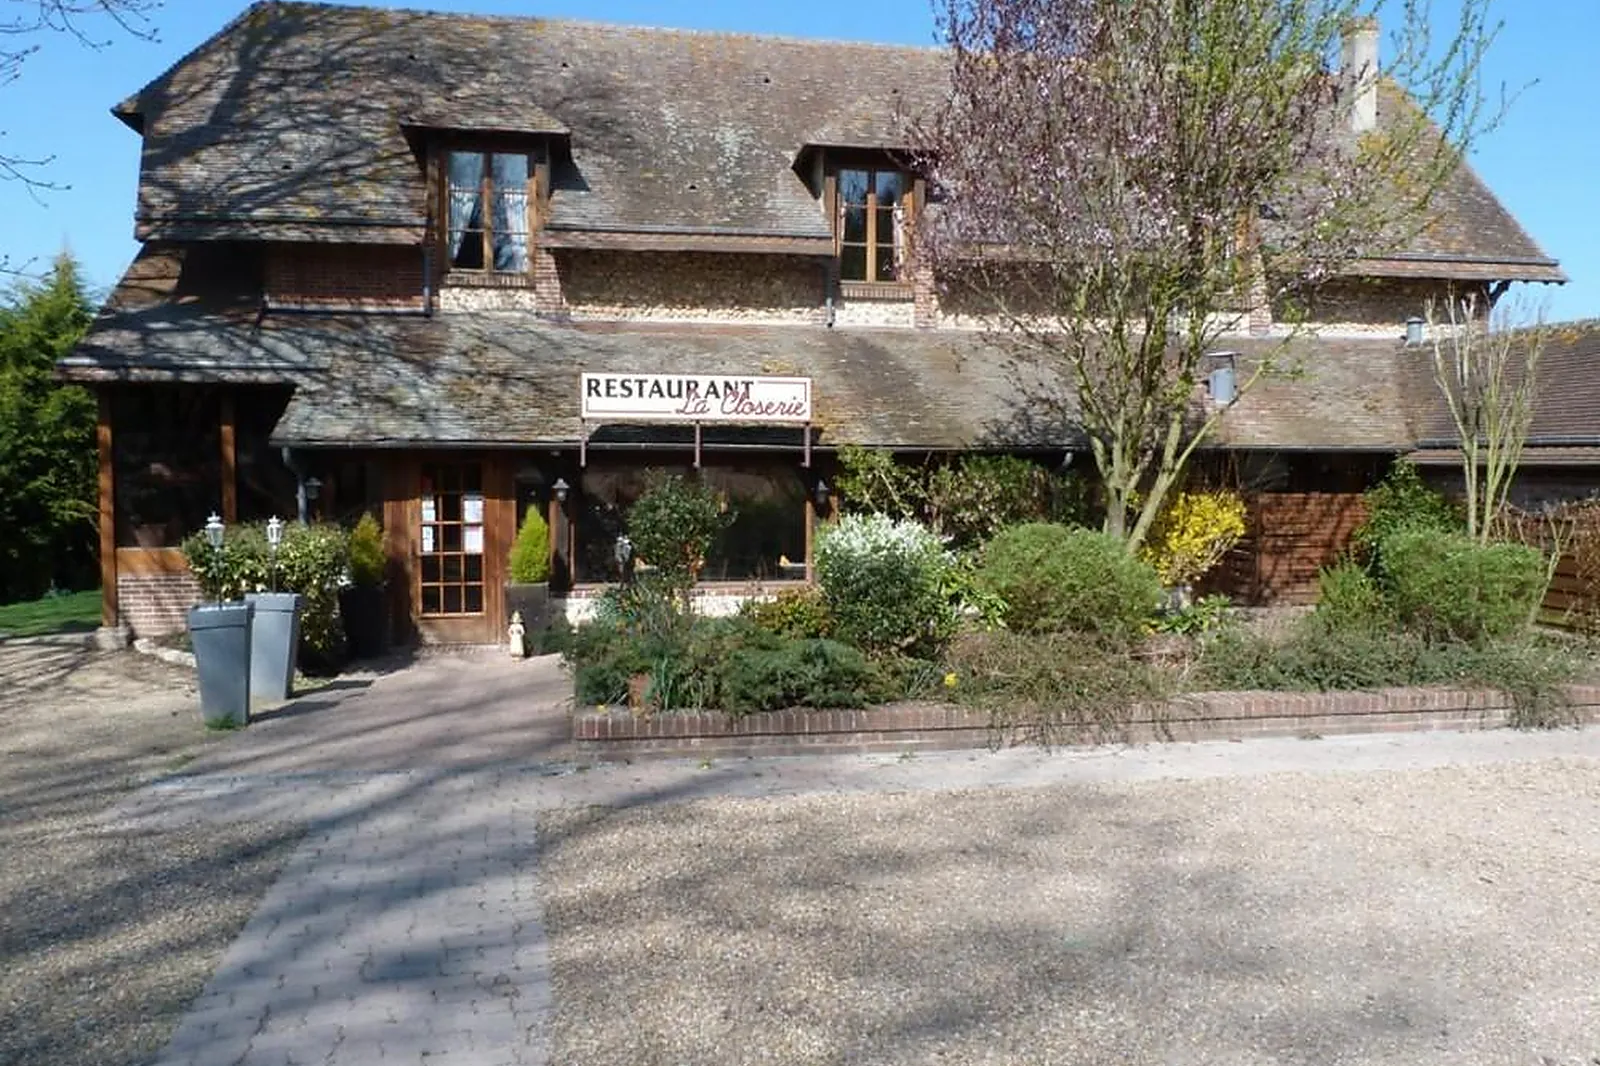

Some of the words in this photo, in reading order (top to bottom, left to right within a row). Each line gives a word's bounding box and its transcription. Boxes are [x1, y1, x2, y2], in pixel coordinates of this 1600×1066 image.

[587, 377, 754, 400] RESTAURANT
[675, 384, 711, 415] La
[720, 386, 807, 416] Closerie
